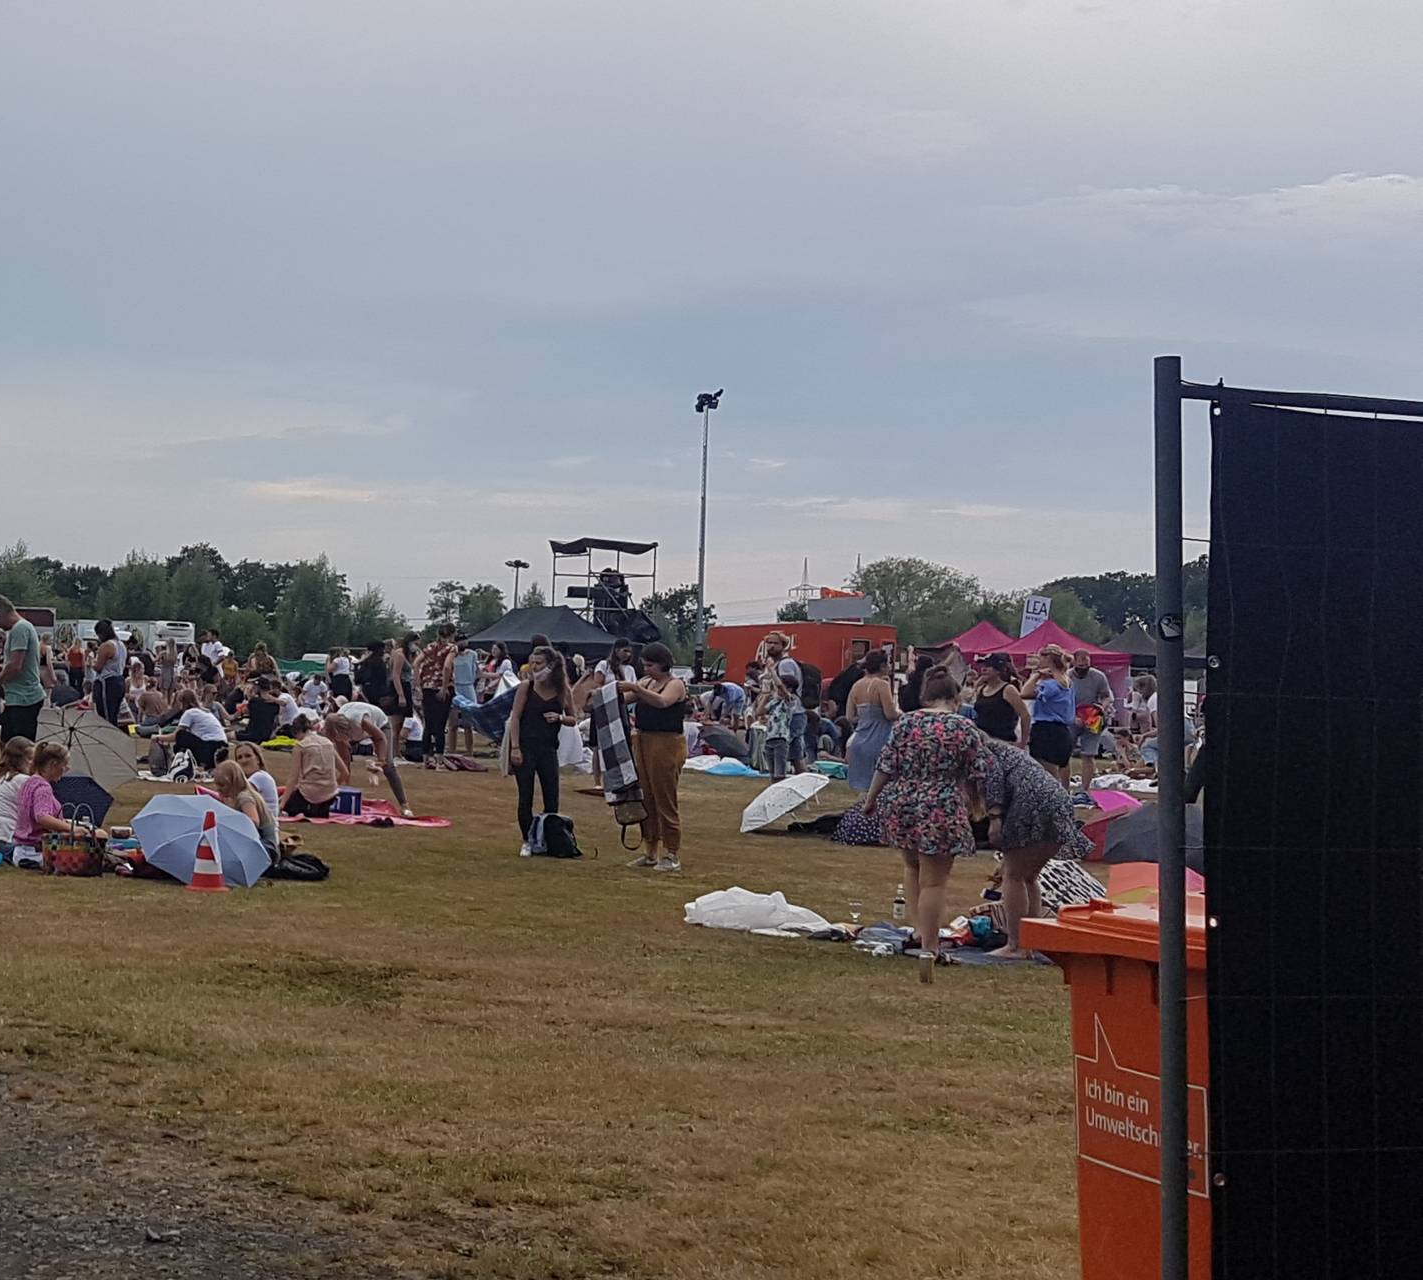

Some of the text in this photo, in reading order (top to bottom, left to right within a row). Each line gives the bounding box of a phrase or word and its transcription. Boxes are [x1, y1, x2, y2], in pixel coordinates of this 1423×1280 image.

[1026, 599, 1047, 617] LEA
[1085, 1076, 1149, 1115] Ich bin ein
